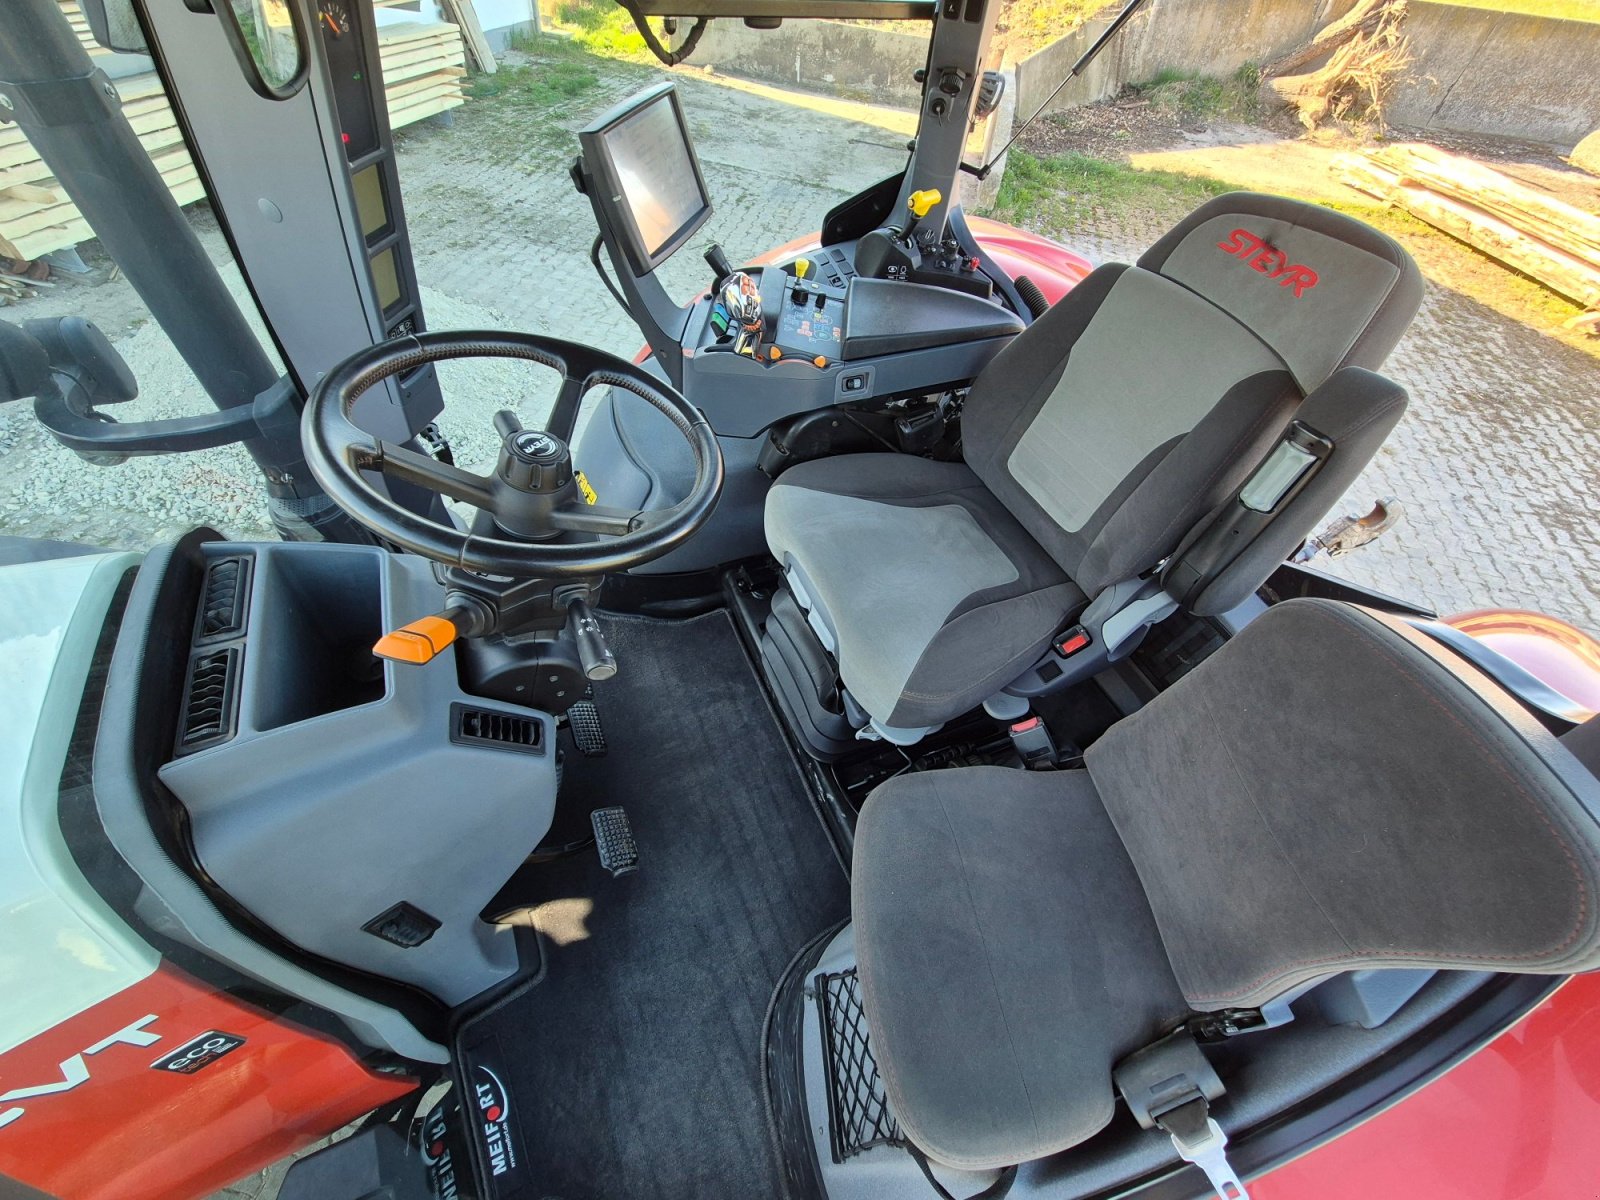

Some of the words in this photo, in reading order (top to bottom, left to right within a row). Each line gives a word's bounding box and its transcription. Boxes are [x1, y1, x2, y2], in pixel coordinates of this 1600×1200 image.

[1216, 228, 1320, 298] STEYR
[523, 435, 553, 454] STEYR
[0, 1014, 163, 1128] VT
[168, 1038, 226, 1069] eco
[476, 1083, 508, 1176] MEIFORT
